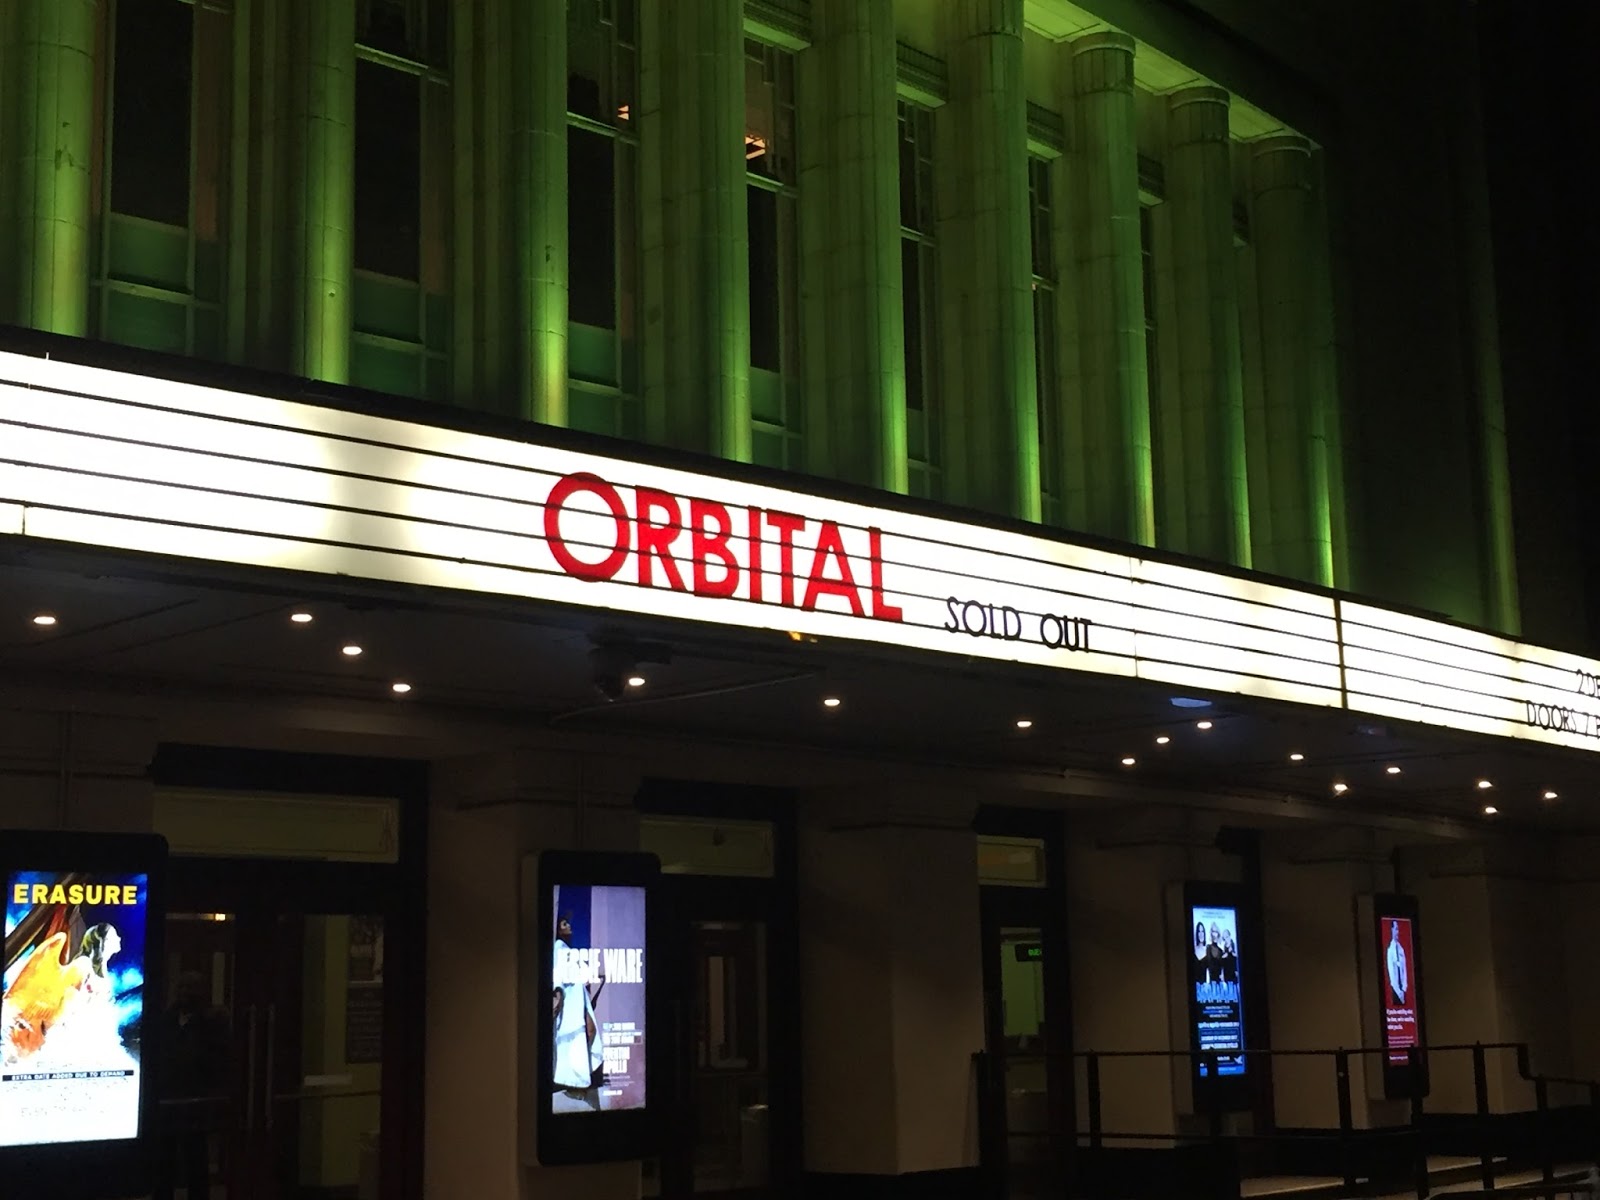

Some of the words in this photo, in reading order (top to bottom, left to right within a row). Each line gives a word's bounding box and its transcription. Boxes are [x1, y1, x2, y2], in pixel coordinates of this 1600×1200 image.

[544, 472, 903, 622] ORBITAL
[944, 596, 1022, 641] SOLD
[1040, 613, 1092, 653] OUT
[1526, 700, 1577, 734] DOORS
[14, 884, 137, 904] ERASURE
[603, 948, 643, 983] WARE
